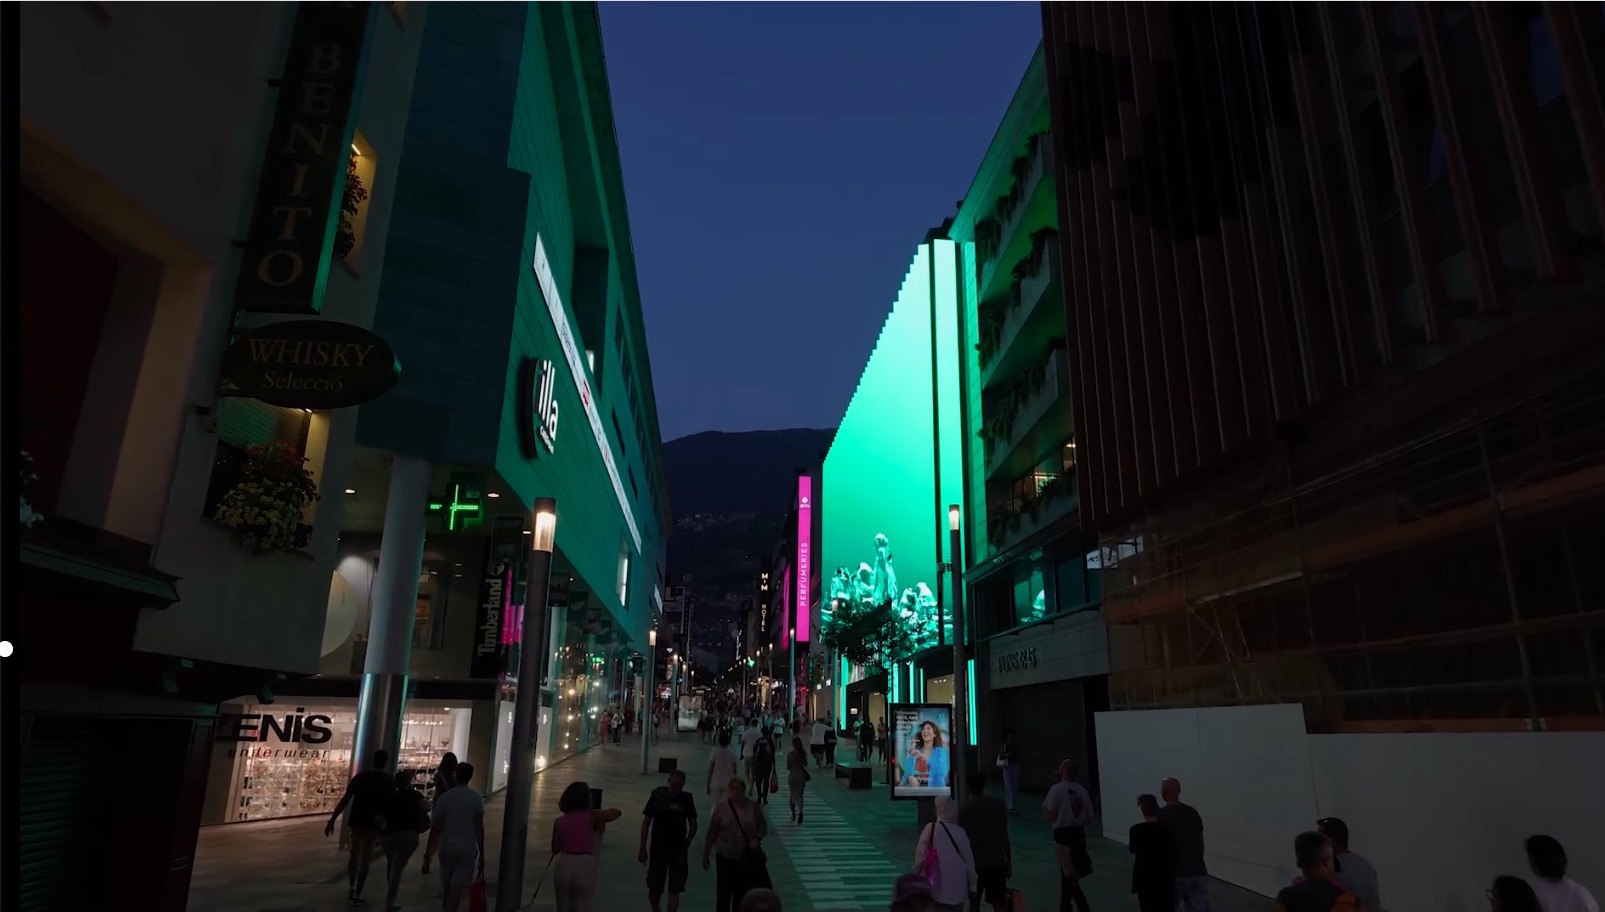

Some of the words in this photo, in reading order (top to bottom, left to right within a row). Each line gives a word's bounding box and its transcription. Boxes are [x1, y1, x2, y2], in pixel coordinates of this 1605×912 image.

[257, 41, 341, 287] BENITO
[249, 338, 375, 368] WHISKY
[262, 370, 343, 392] Selecció
[538, 360, 559, 441] illa
[800, 542, 808, 607] PERFUMERIES
[477, 579, 503, 657] Timberland
[228, 747, 328, 759] underwear
